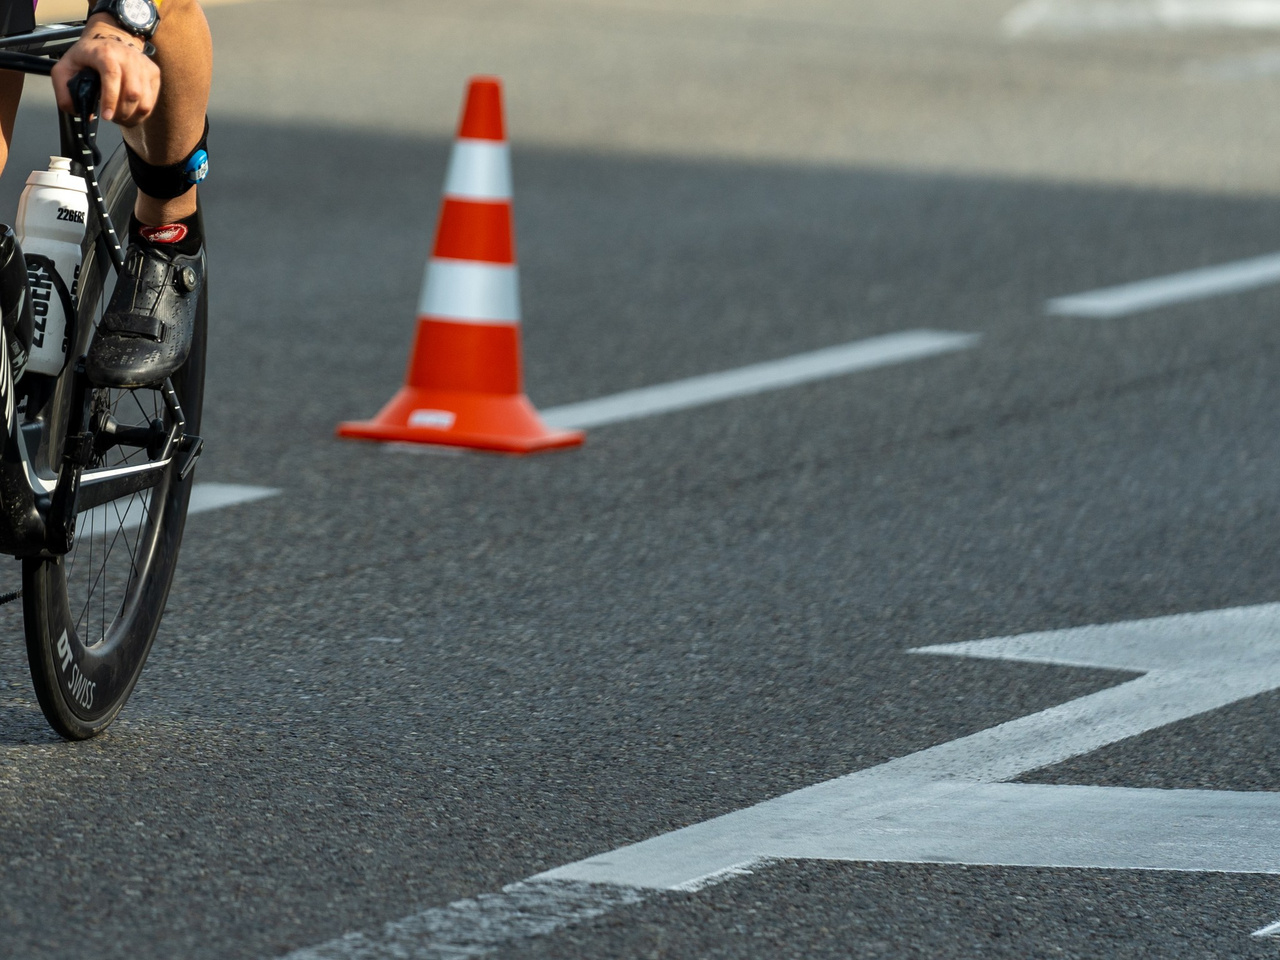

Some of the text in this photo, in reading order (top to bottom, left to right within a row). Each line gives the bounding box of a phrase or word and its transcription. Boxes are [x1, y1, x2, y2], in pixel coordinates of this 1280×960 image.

[56, 207, 85, 224] 226ERS
[57, 627, 96, 710] DT SWISS
